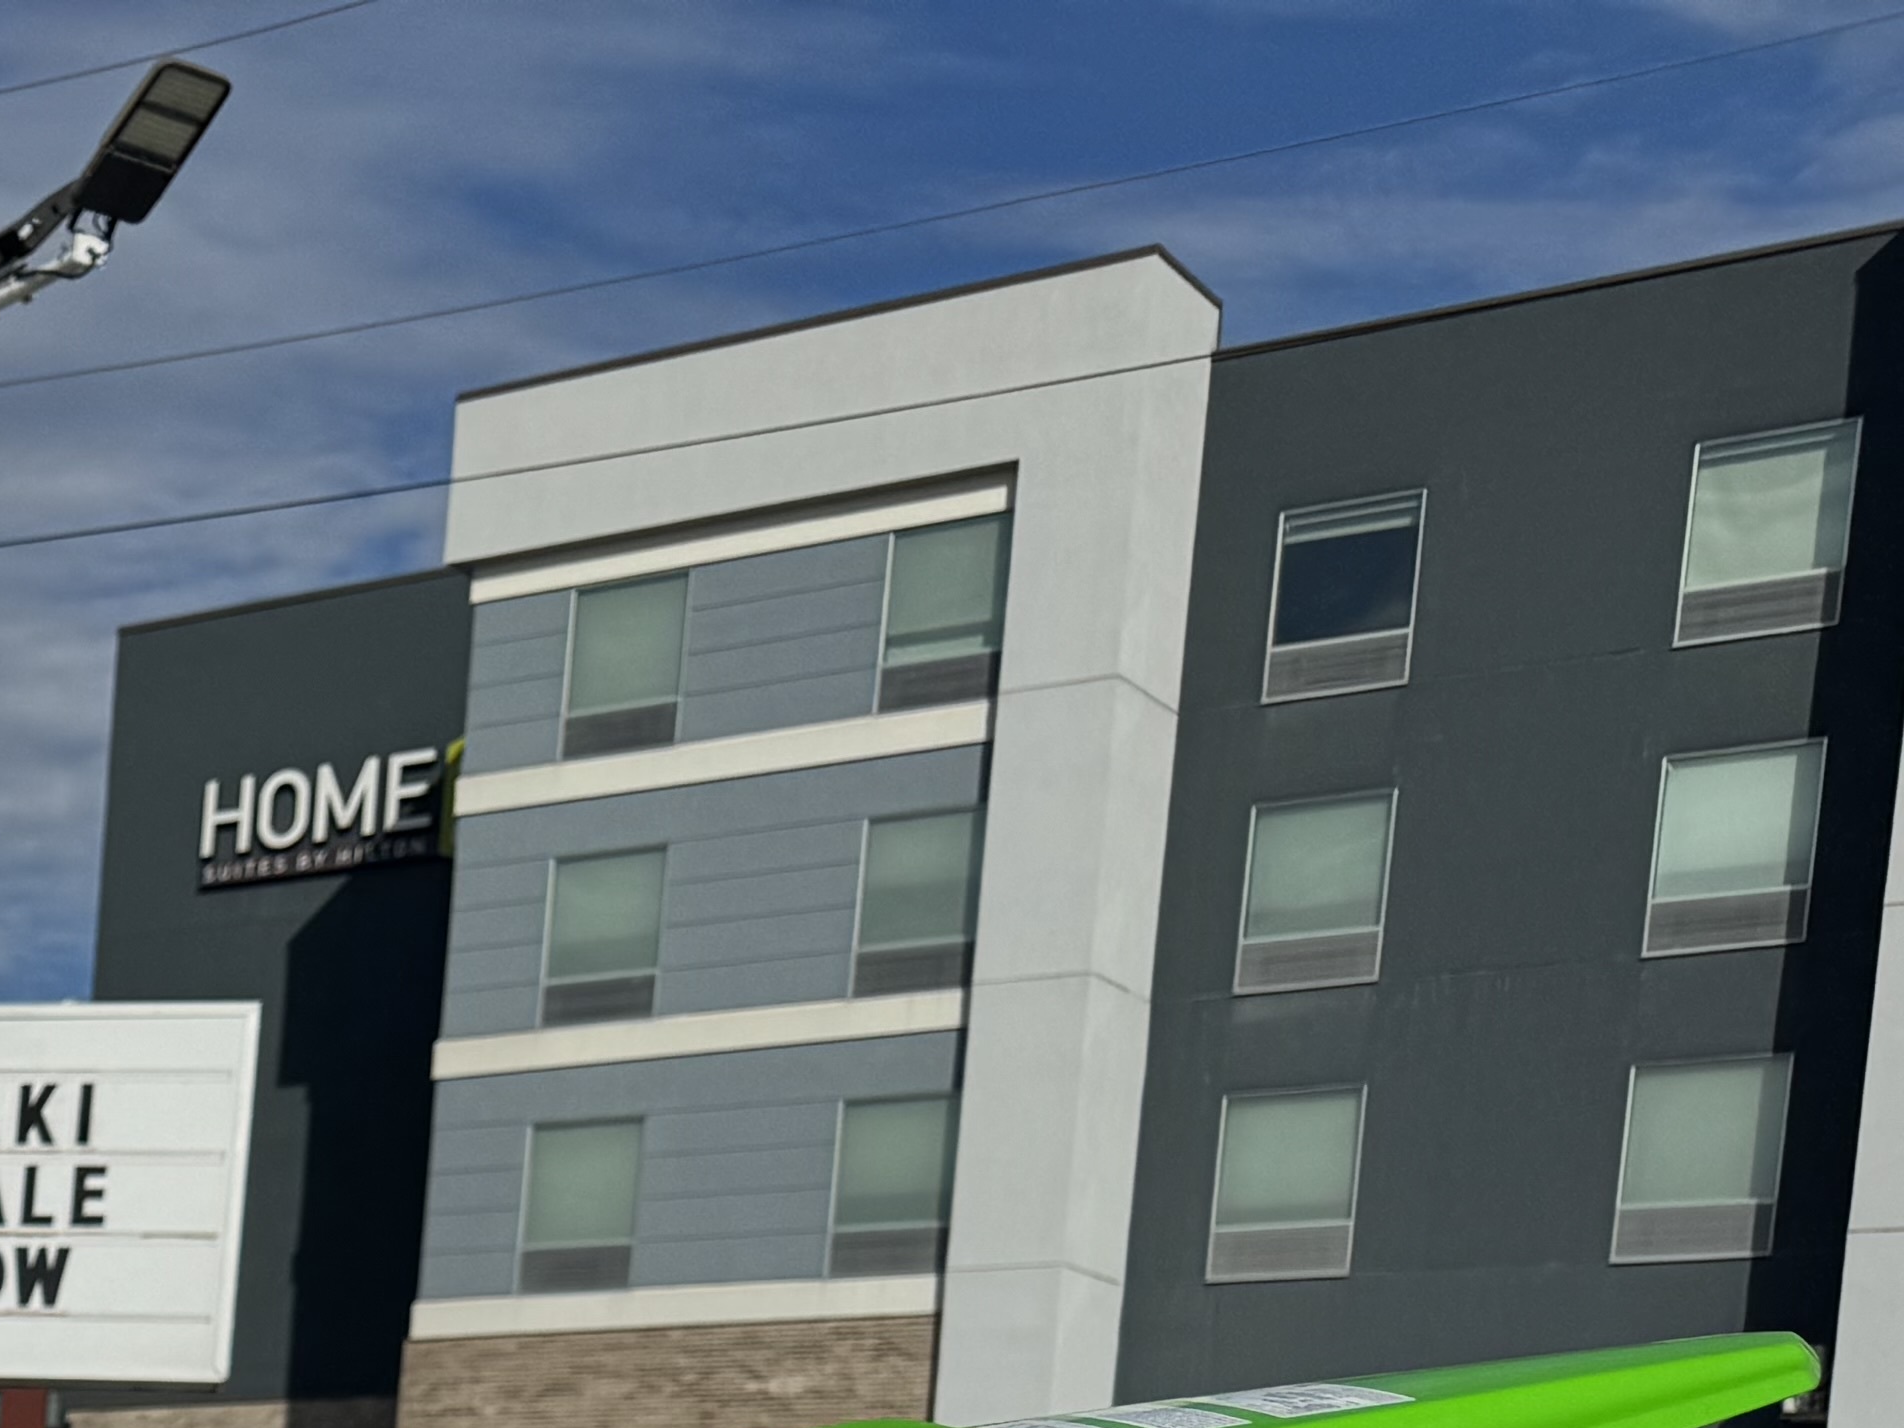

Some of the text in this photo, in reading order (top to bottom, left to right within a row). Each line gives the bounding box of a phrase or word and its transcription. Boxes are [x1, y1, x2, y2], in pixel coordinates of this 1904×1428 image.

[198, 746, 439, 860] HOME
[202, 856, 290, 886] SUITES
[295, 851, 329, 873] BY
